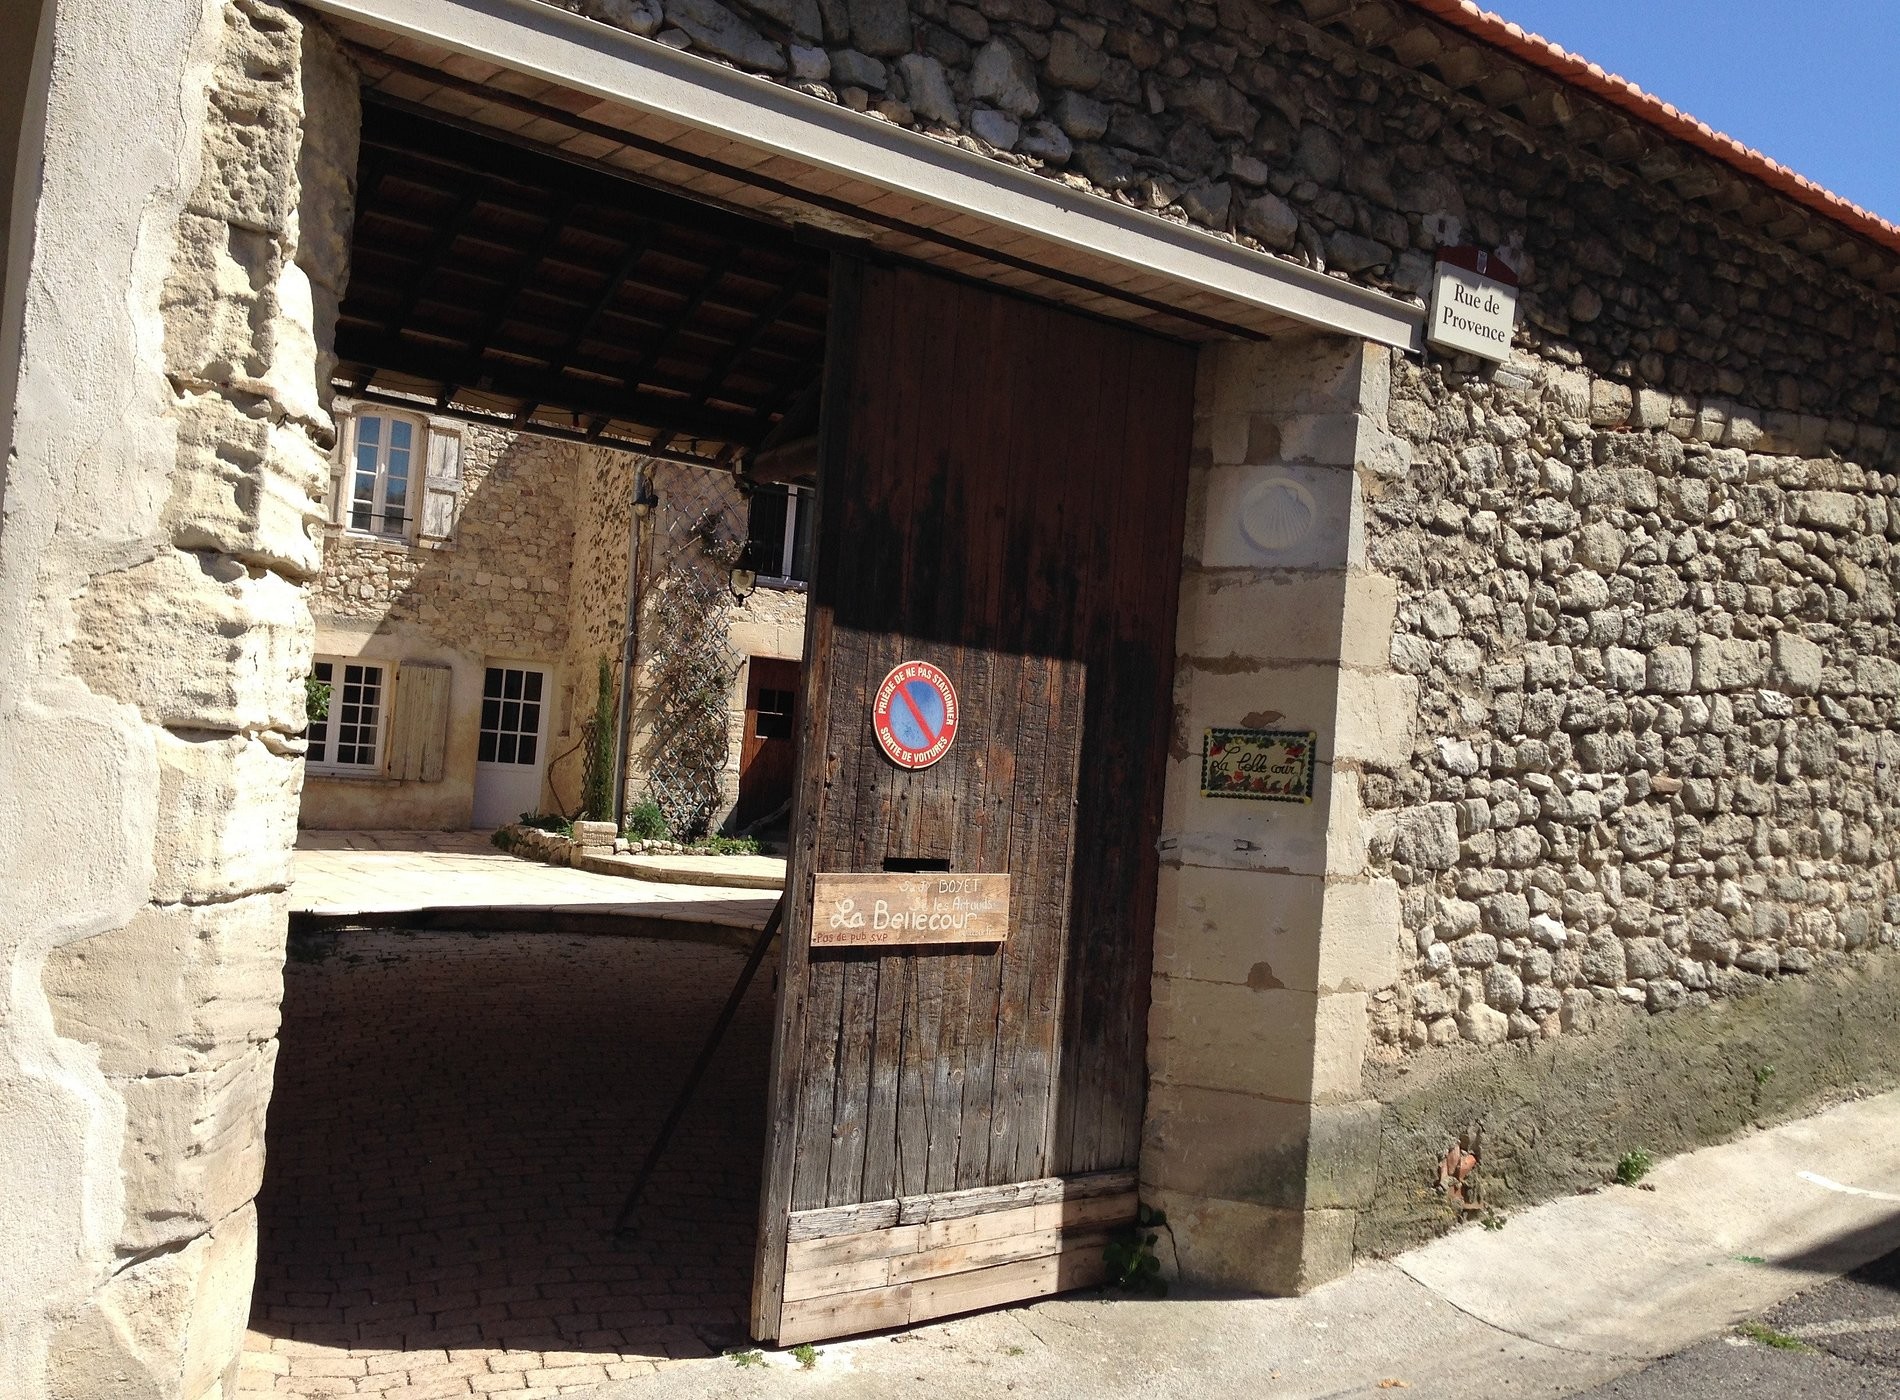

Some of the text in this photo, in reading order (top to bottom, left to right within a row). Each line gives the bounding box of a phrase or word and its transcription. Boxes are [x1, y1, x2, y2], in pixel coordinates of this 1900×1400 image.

[1454, 283, 1500, 315] Rue de
[1443, 306, 1505, 343] Provence
[878, 667, 955, 726] PRIÈRE DE NE PAS STATIONNER
[880, 727, 948, 763] SORTIE DE VOITURES
[1211, 746, 1295, 775] La belle cour
[939, 878, 981, 893] BOYET
[830, 898, 866, 928] La
[873, 899, 978, 931] Bellecour
[933, 897, 950, 911] les
[817, 932, 834, 943] Pas
[836, 932, 847, 942] de
